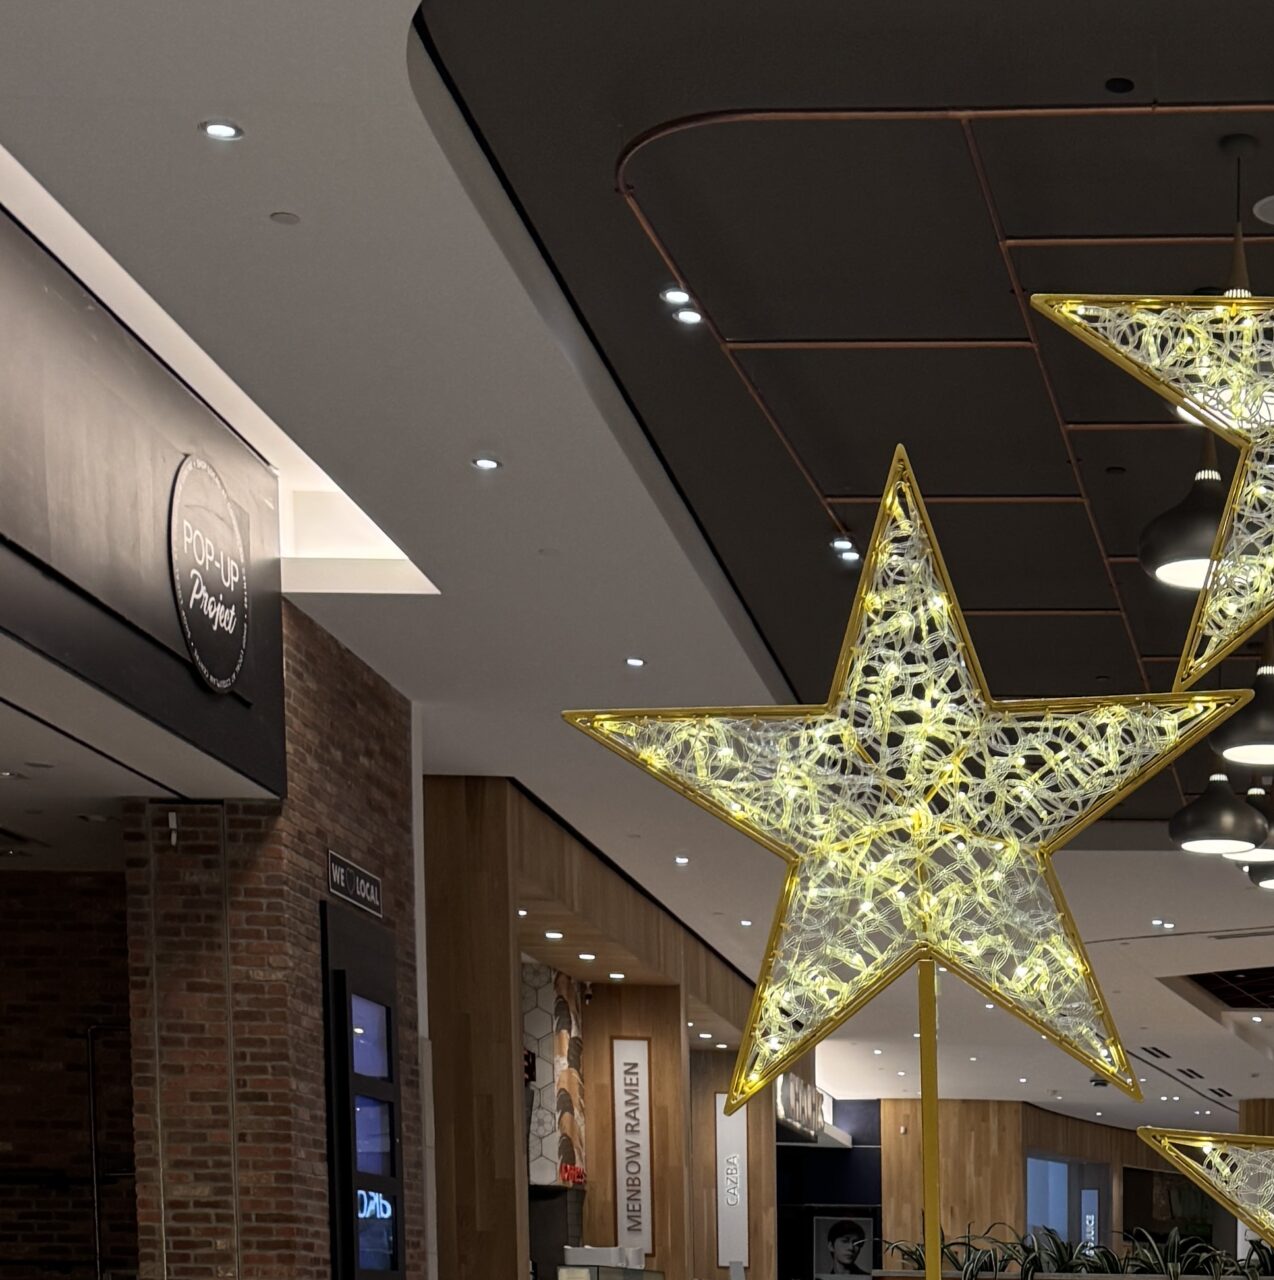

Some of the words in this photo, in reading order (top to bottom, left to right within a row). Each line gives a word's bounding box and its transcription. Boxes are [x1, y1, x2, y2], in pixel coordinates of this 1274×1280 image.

[183, 519, 239, 592] POP-UP
[189, 568, 237, 634] Project
[331, 862, 345, 887] WE
[356, 875, 380, 906] LOCAL
[623, 1061, 641, 1135] RAMEN
[625, 1139, 642, 1232] MENBOW
[725, 1154, 740, 1207] CAZBA
